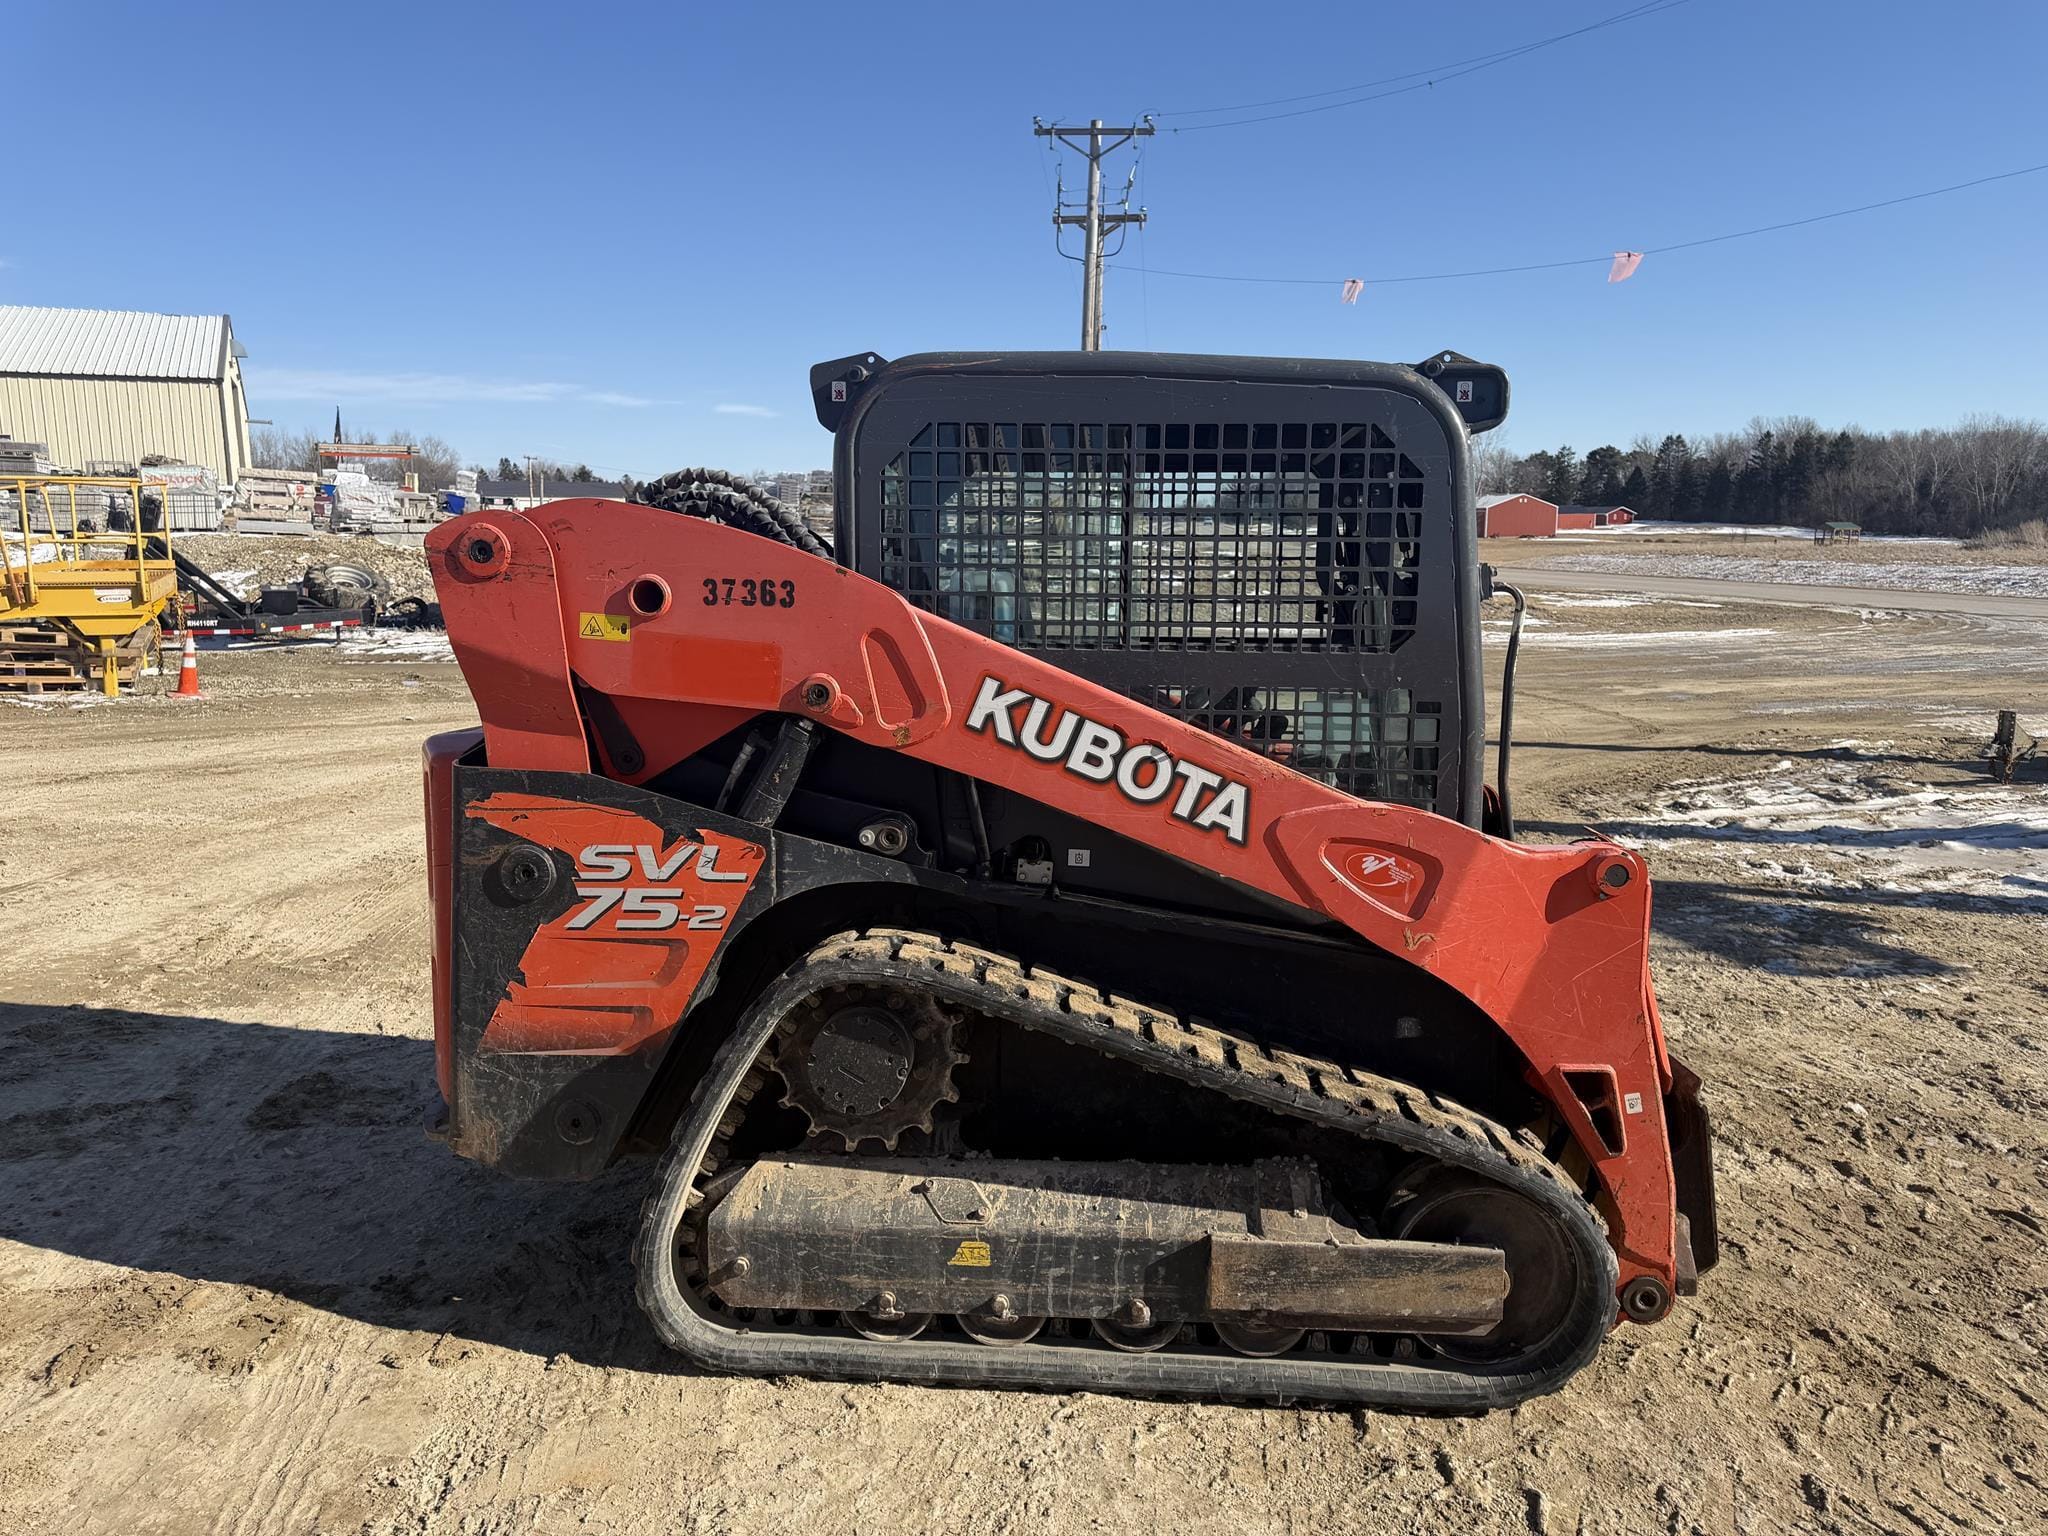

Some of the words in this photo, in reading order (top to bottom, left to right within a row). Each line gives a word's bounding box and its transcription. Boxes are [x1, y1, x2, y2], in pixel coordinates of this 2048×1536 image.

[702, 578, 795, 608] 37363
[966, 676, 1248, 844] KUBOTA
[578, 844, 749, 882] SVL
[564, 887, 728, 930] 75-2
